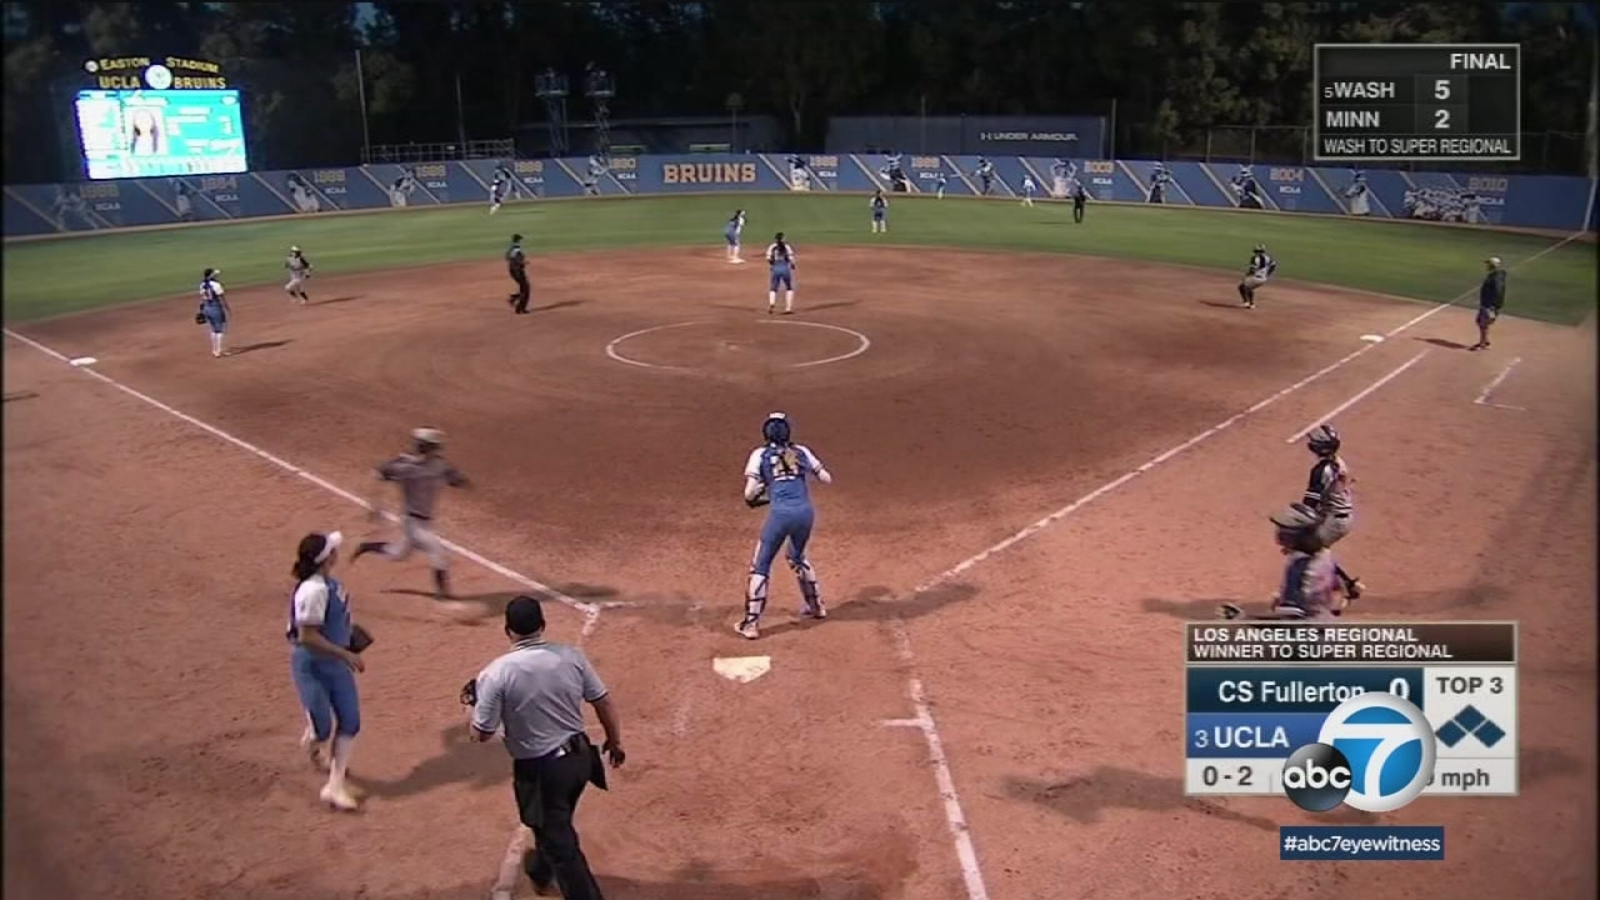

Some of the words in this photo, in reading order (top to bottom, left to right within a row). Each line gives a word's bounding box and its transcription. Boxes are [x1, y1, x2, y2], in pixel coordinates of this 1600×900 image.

[100, 57, 149, 71] EASTON
[166, 57, 219, 73] STADIUM
[99, 76, 141, 89] UCLA
[174, 77, 226, 89] BRUINS
[993, 132, 1028, 141] UNDER
[663, 163, 756, 183] BRUINS
